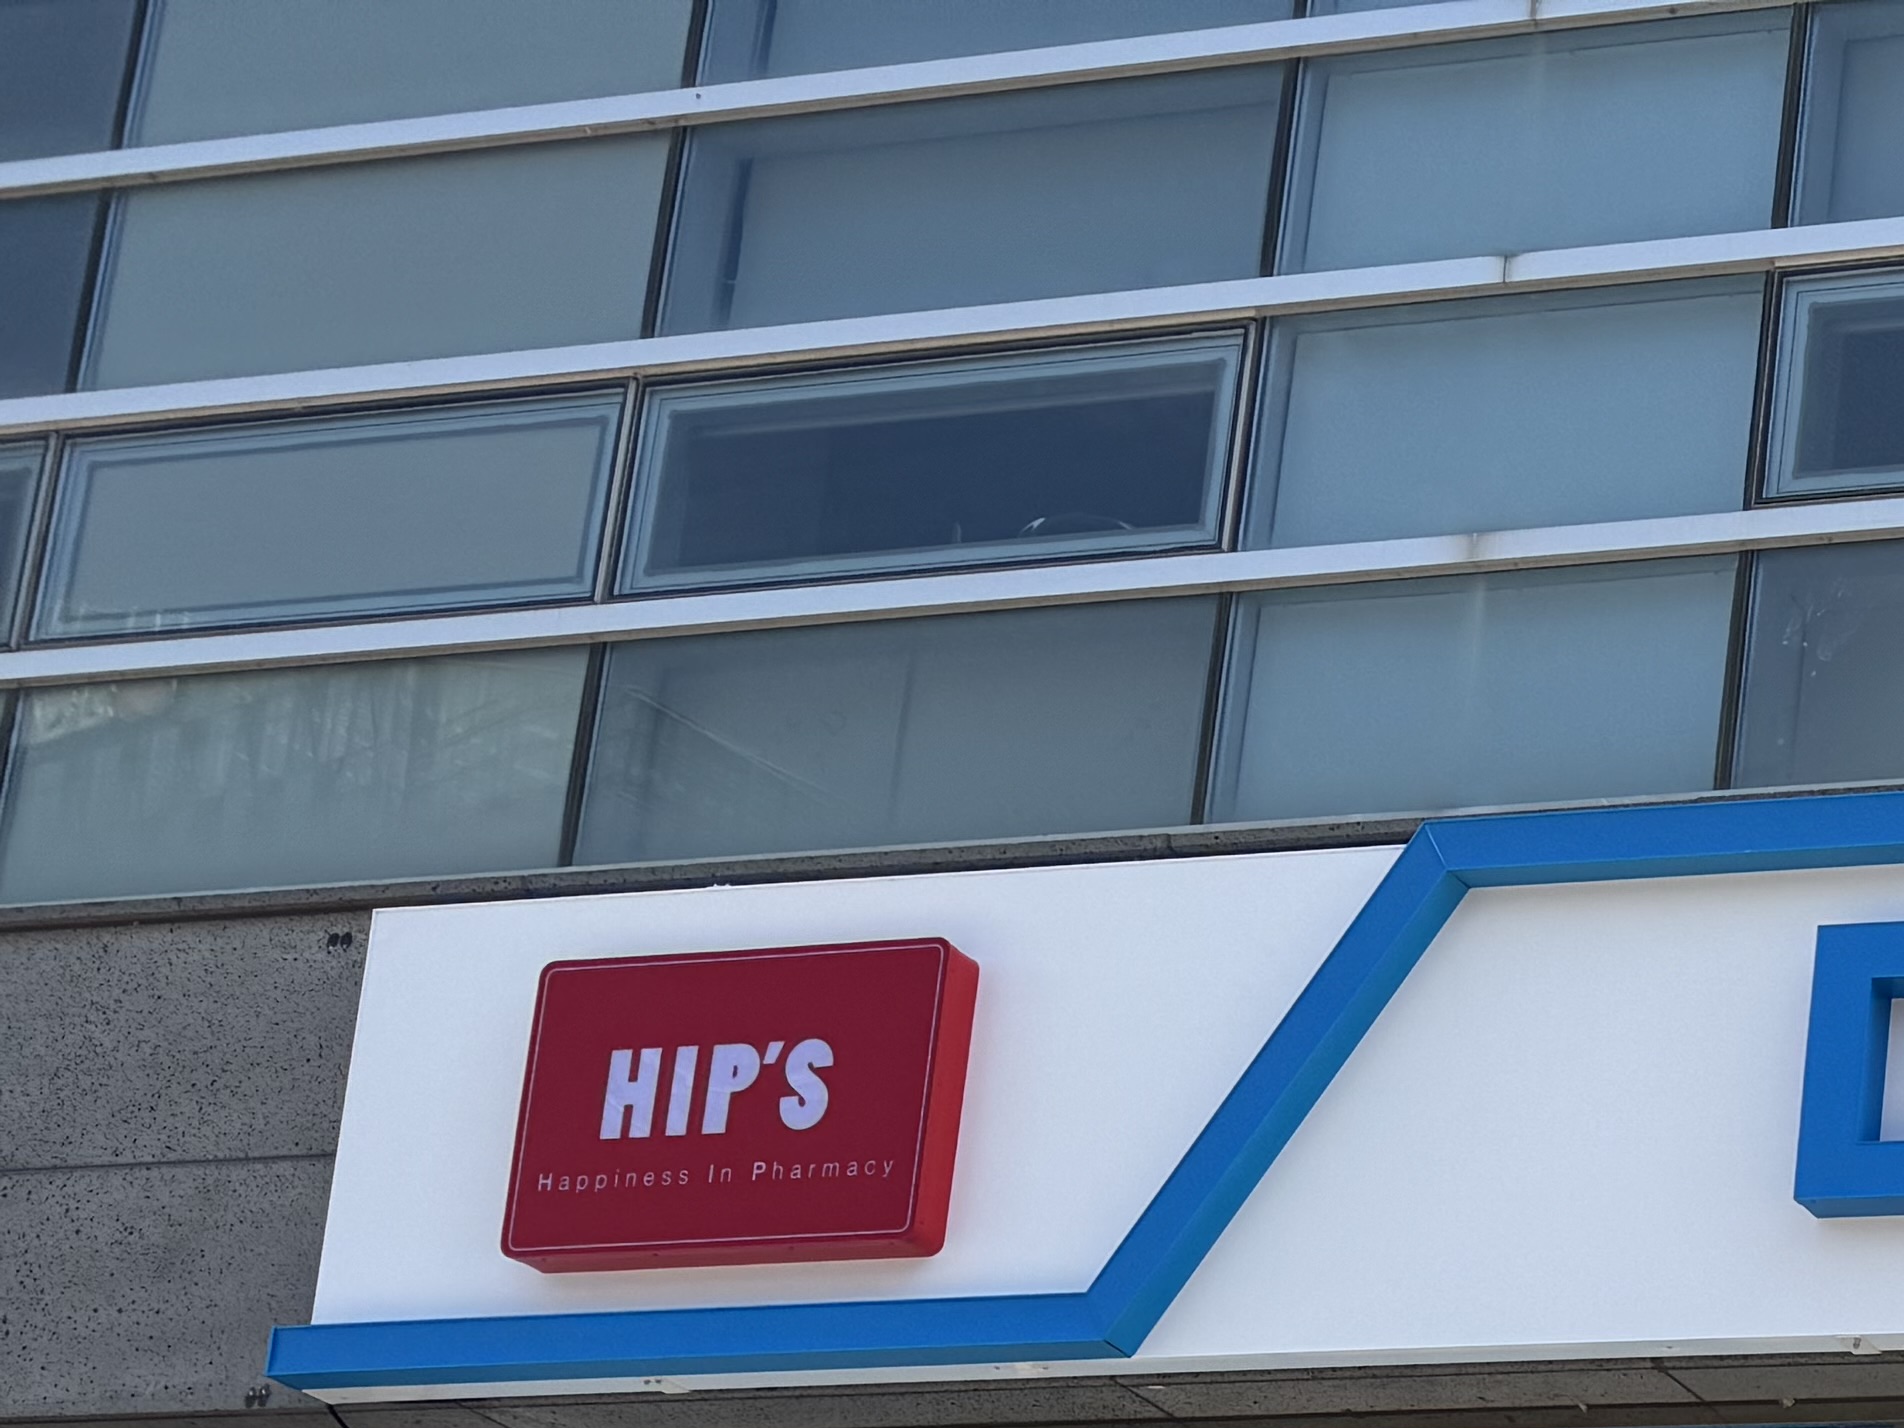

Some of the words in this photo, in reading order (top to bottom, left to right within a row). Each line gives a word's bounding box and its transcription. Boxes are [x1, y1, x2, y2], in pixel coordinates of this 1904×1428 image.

[600, 1038, 834, 1139] HIP'S
[538, 1168, 690, 1193] Happiness
[709, 1165, 732, 1183] In
[752, 1158, 895, 1182] Pharmacy
